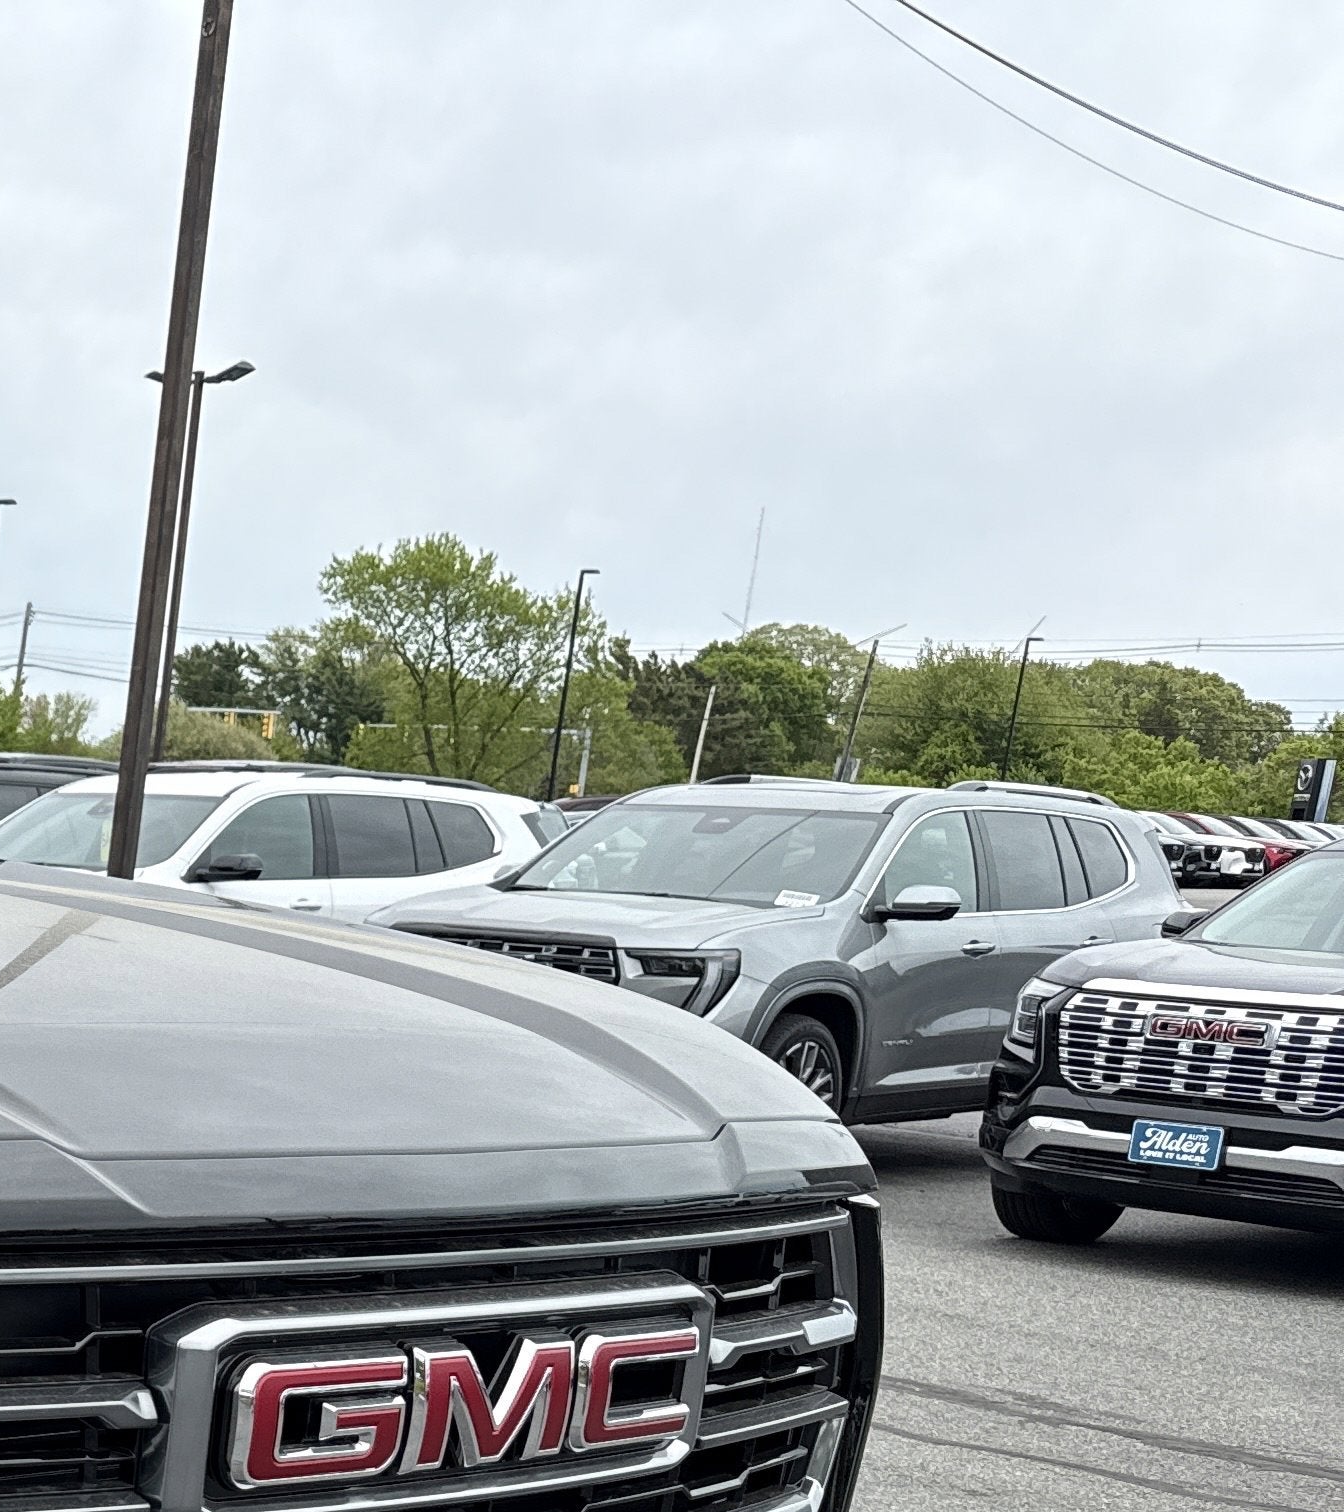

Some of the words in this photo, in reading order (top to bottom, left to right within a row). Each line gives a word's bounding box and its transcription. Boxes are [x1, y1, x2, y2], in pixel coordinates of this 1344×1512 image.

[1151, 1016, 1268, 1046] GMC
[1139, 1127, 1210, 1154] Alden
[1186, 1133, 1210, 1142] AUTO
[1176, 1153, 1207, 1163] LOCAL
[230, 1326, 699, 1490] GMC
